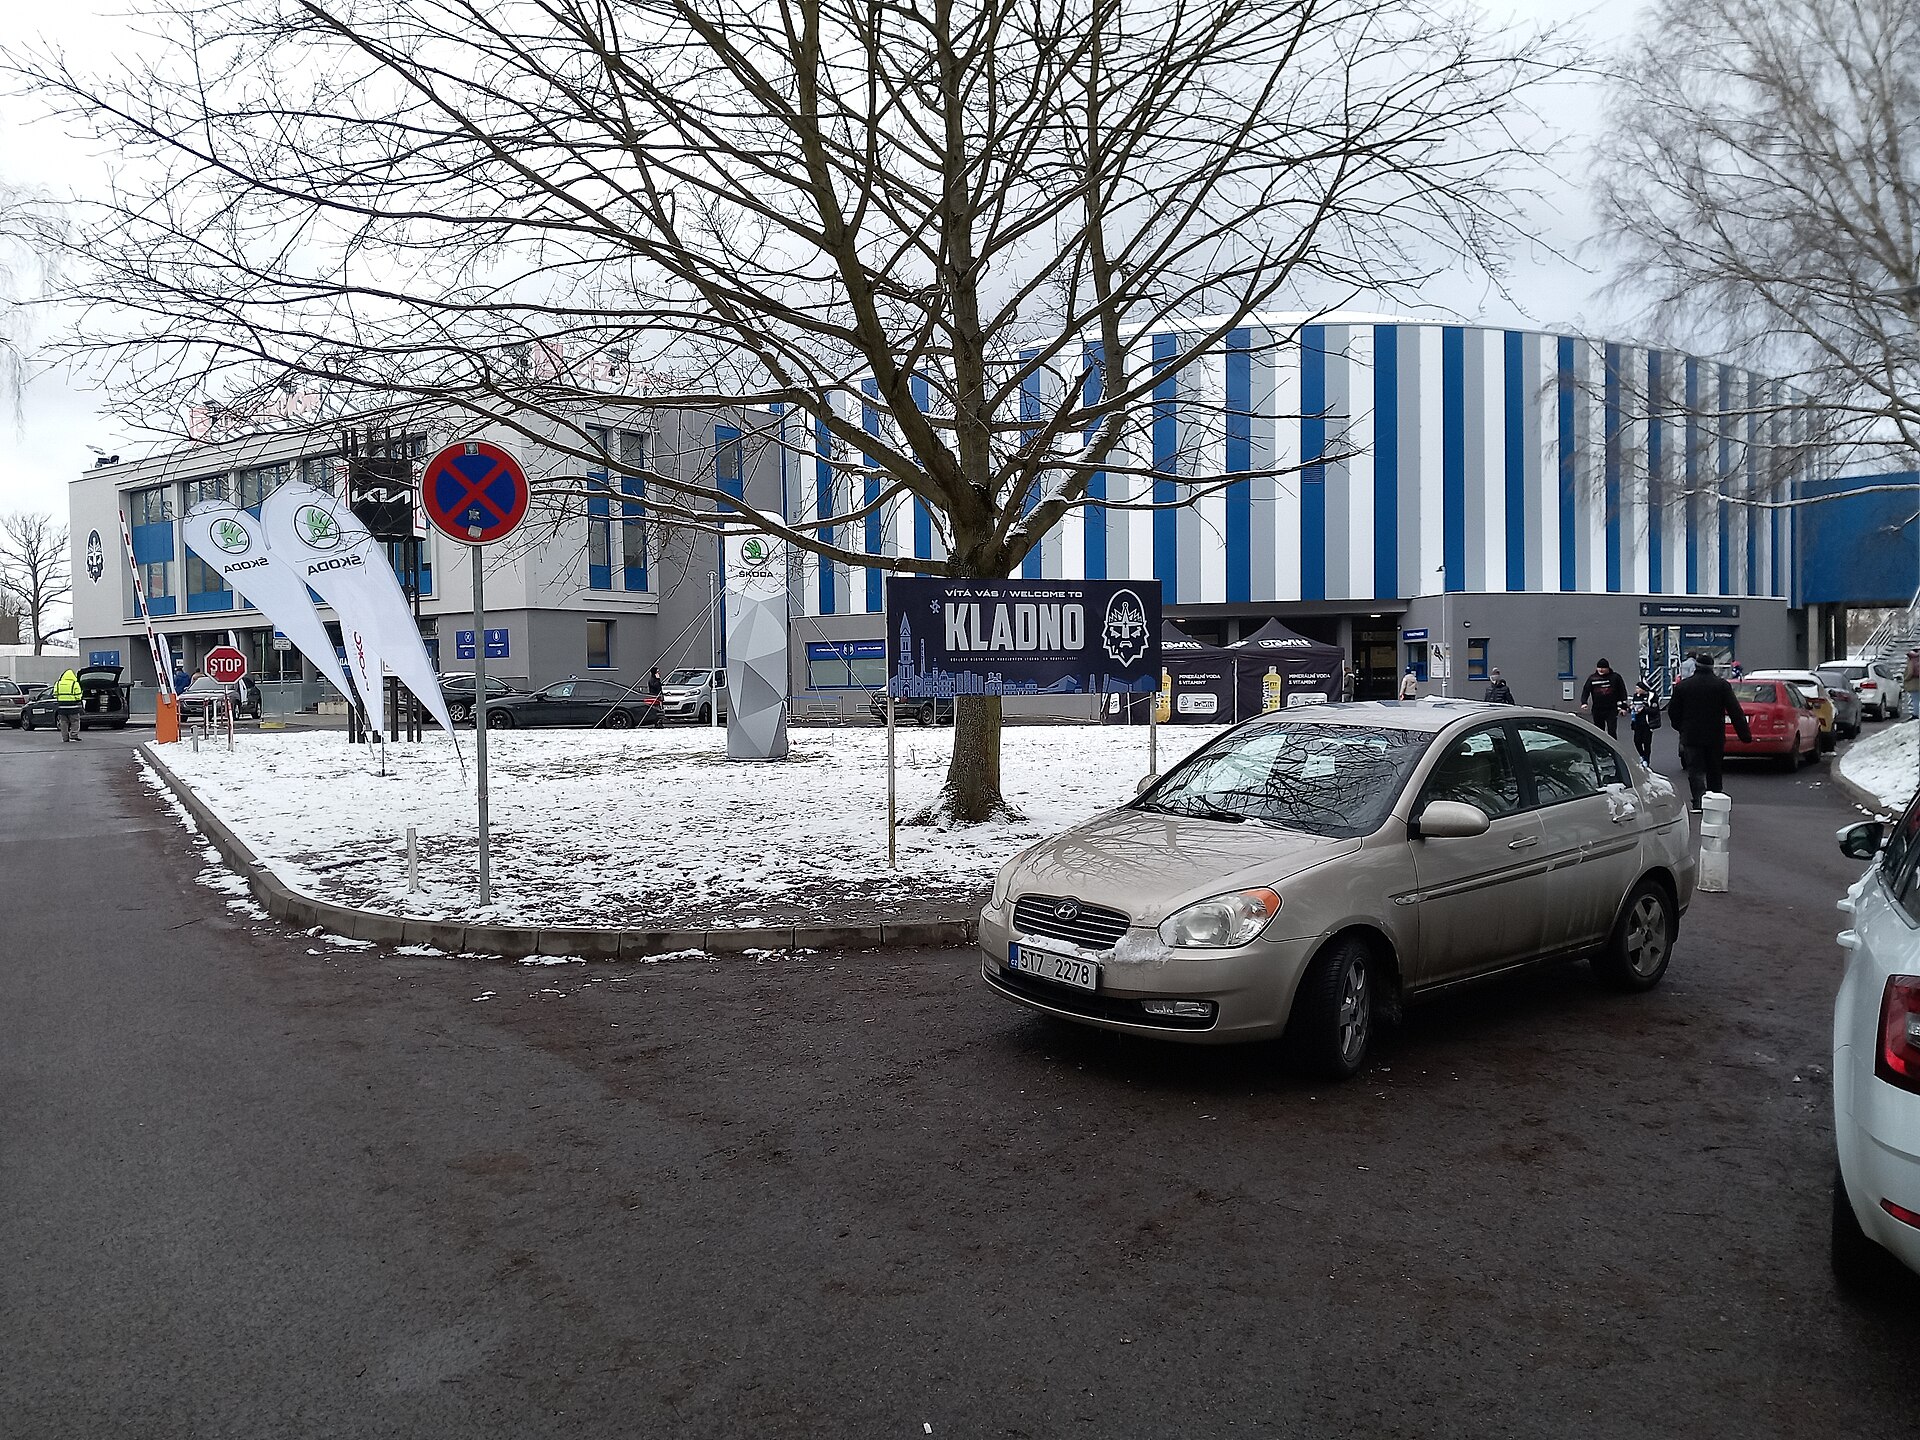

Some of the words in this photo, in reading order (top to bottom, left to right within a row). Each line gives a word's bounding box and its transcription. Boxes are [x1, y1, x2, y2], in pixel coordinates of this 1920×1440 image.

[739, 570, 774, 578] ŠKODA
[944, 588, 972, 598] VÍTÁ
[974, 588, 999, 598] VÁS
[1009, 590, 1066, 598] WELCOME
[944, 602, 1085, 651] KLADNO
[210, 658, 242, 673] STOP
[1020, 950, 1044, 973] 5T7
[1055, 958, 1090, 985] 2278
